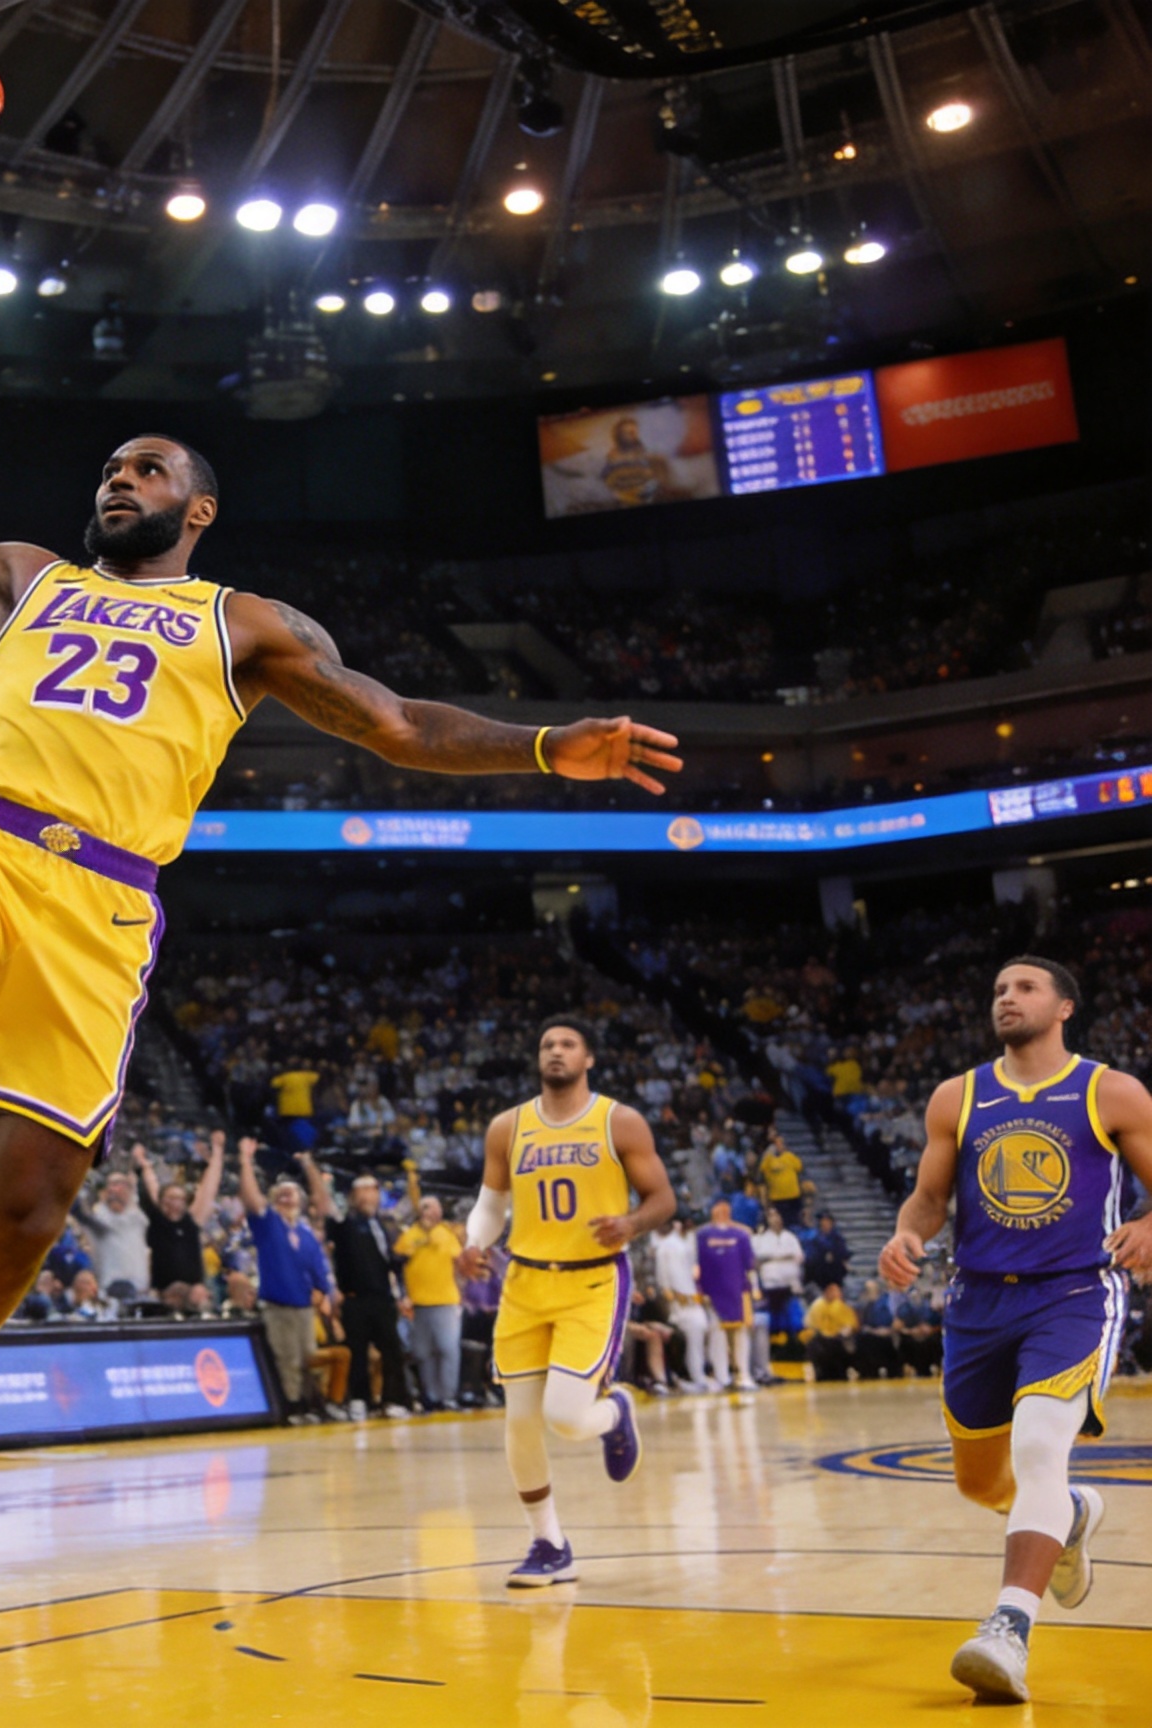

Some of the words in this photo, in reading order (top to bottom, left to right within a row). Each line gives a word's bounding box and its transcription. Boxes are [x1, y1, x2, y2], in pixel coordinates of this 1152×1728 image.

[23, 588, 201, 646] LAKERS
[31, 632, 159, 722] 23
[537, 1177, 577, 1221] 10
